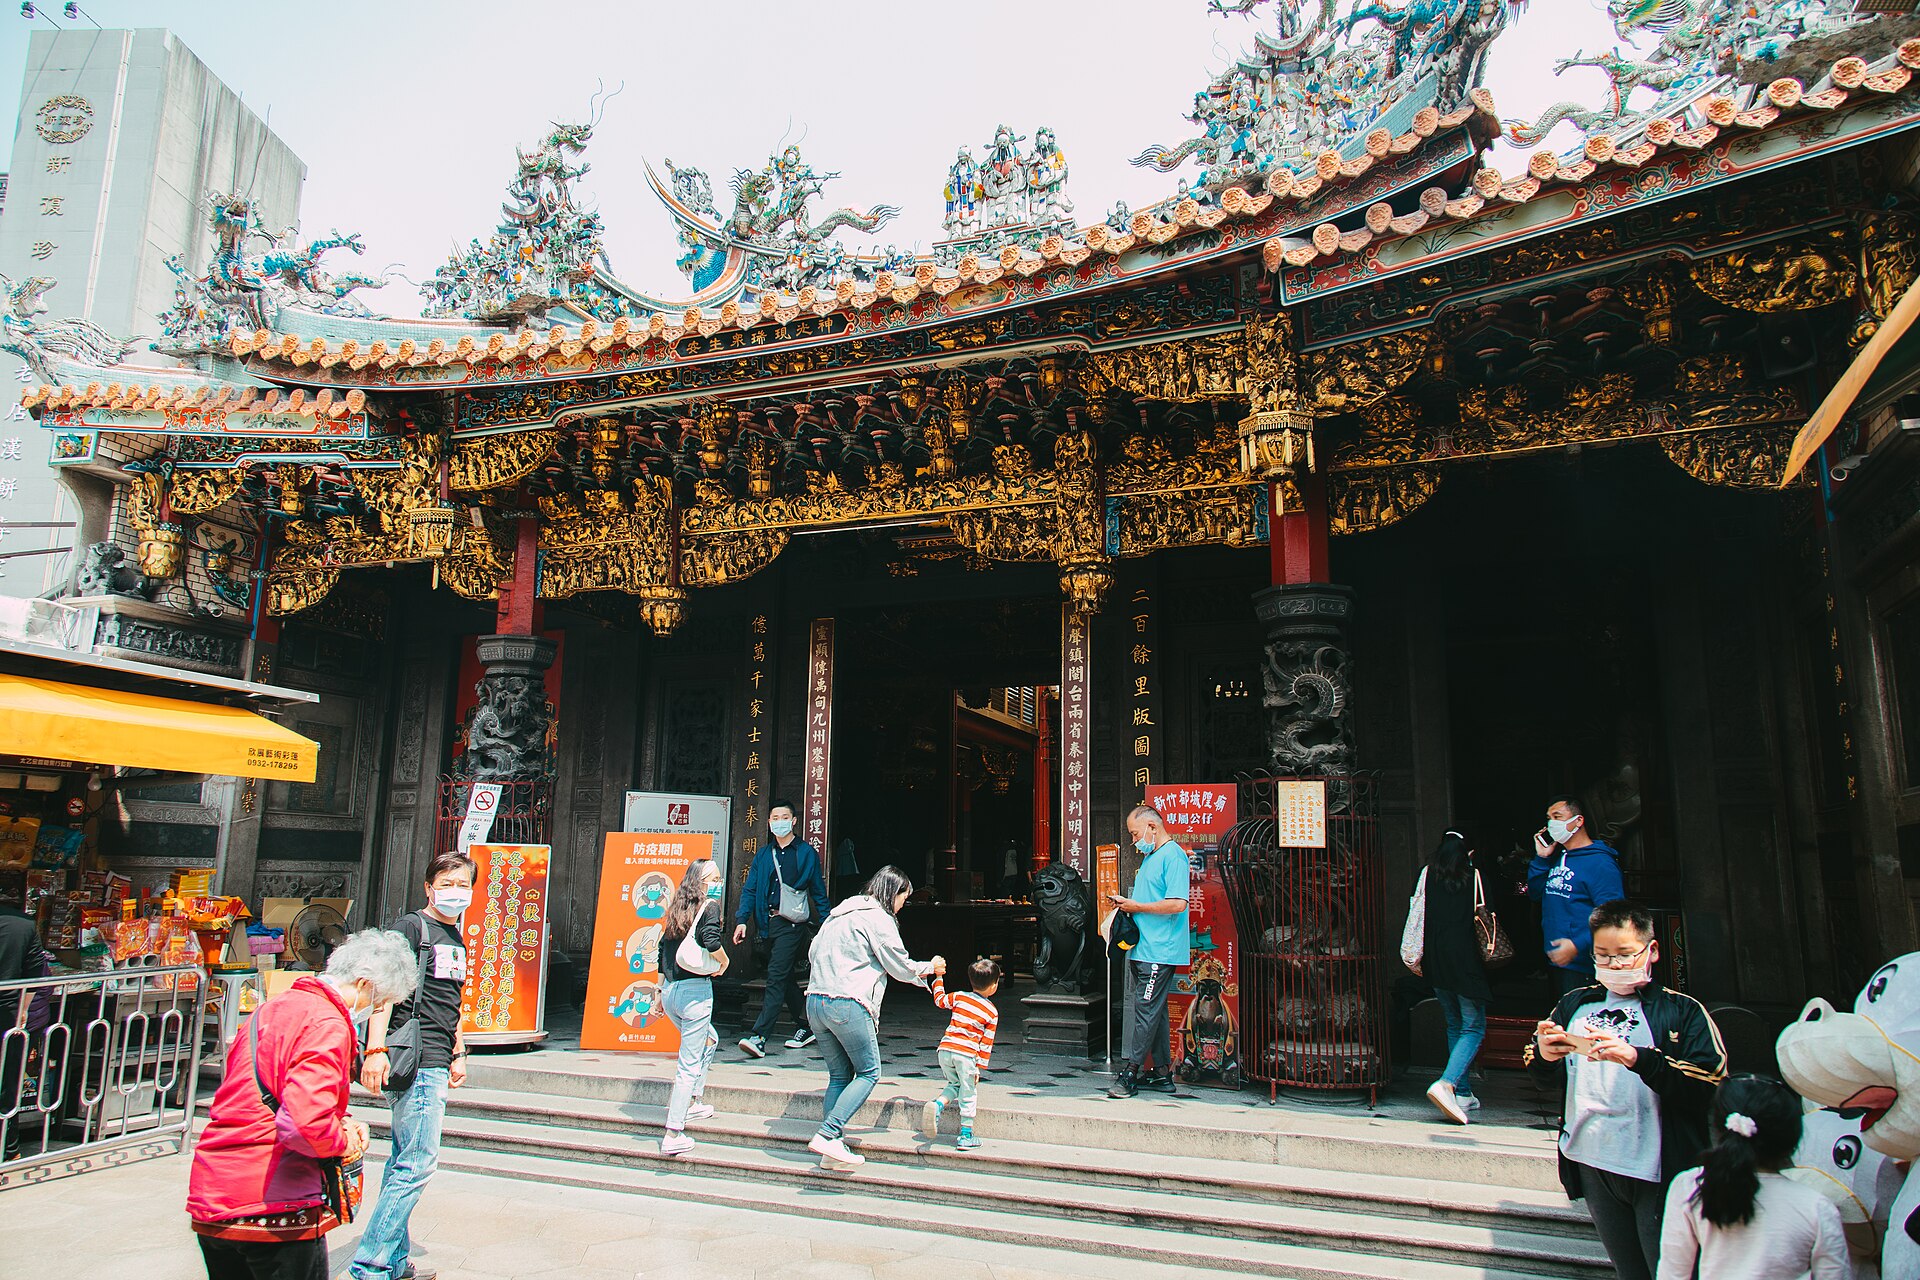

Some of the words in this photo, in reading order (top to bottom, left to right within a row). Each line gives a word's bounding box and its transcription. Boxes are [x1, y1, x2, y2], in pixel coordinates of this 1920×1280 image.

[1130, 589, 1154, 806] 二百餘里版圖同
[248, 759, 298, 769] 0932-178295
[1154, 789, 1227, 812] 新竹都城隍廟
[1166, 813, 1213, 825] 專屬公仔
[1186, 825, 1194, 833] 之
[633, 843, 683, 856] 防疫期間
[522, 903, 540, 947] 歡迎
[614, 940, 624, 957] 酒精
